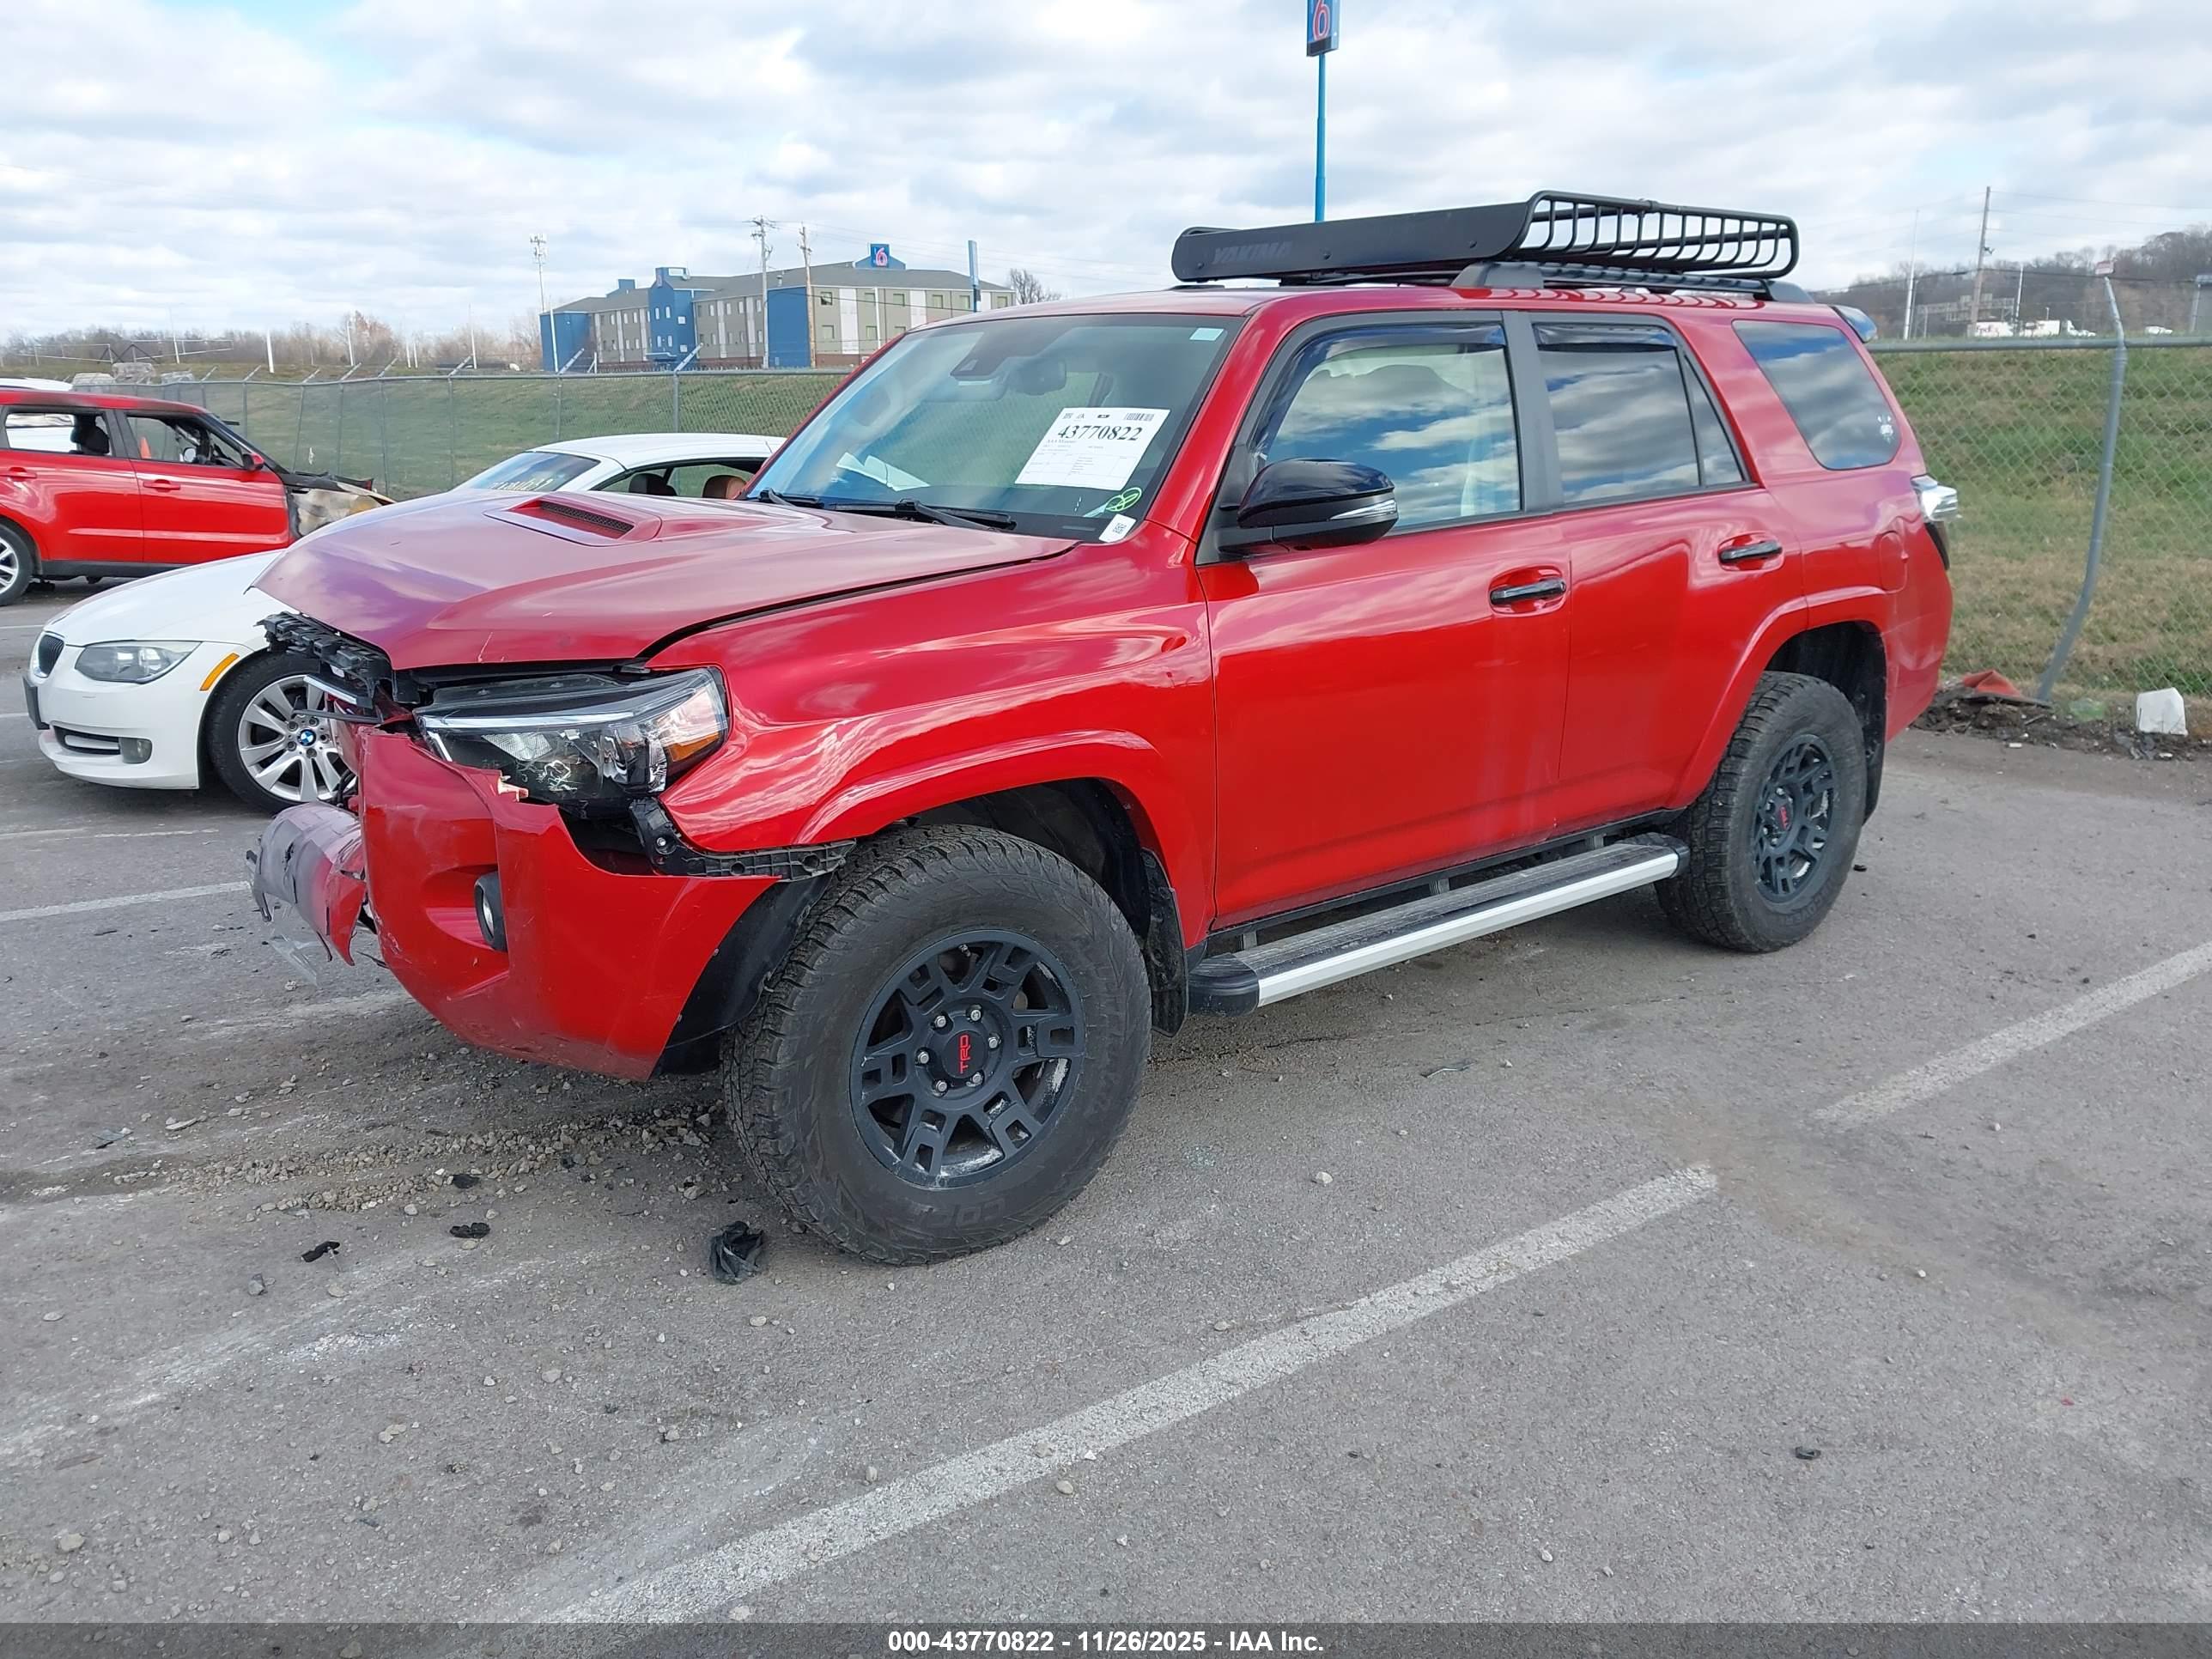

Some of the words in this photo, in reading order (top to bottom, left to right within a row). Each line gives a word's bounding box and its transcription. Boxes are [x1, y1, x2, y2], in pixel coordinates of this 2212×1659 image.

[1313, 0, 1330, 40] 6
[876, 247, 887, 266] 6
[1212, 241, 1291, 264] YAKIMA
[1058, 425, 1143, 441] 43770822
[960, 1034, 971, 1074] TRD
